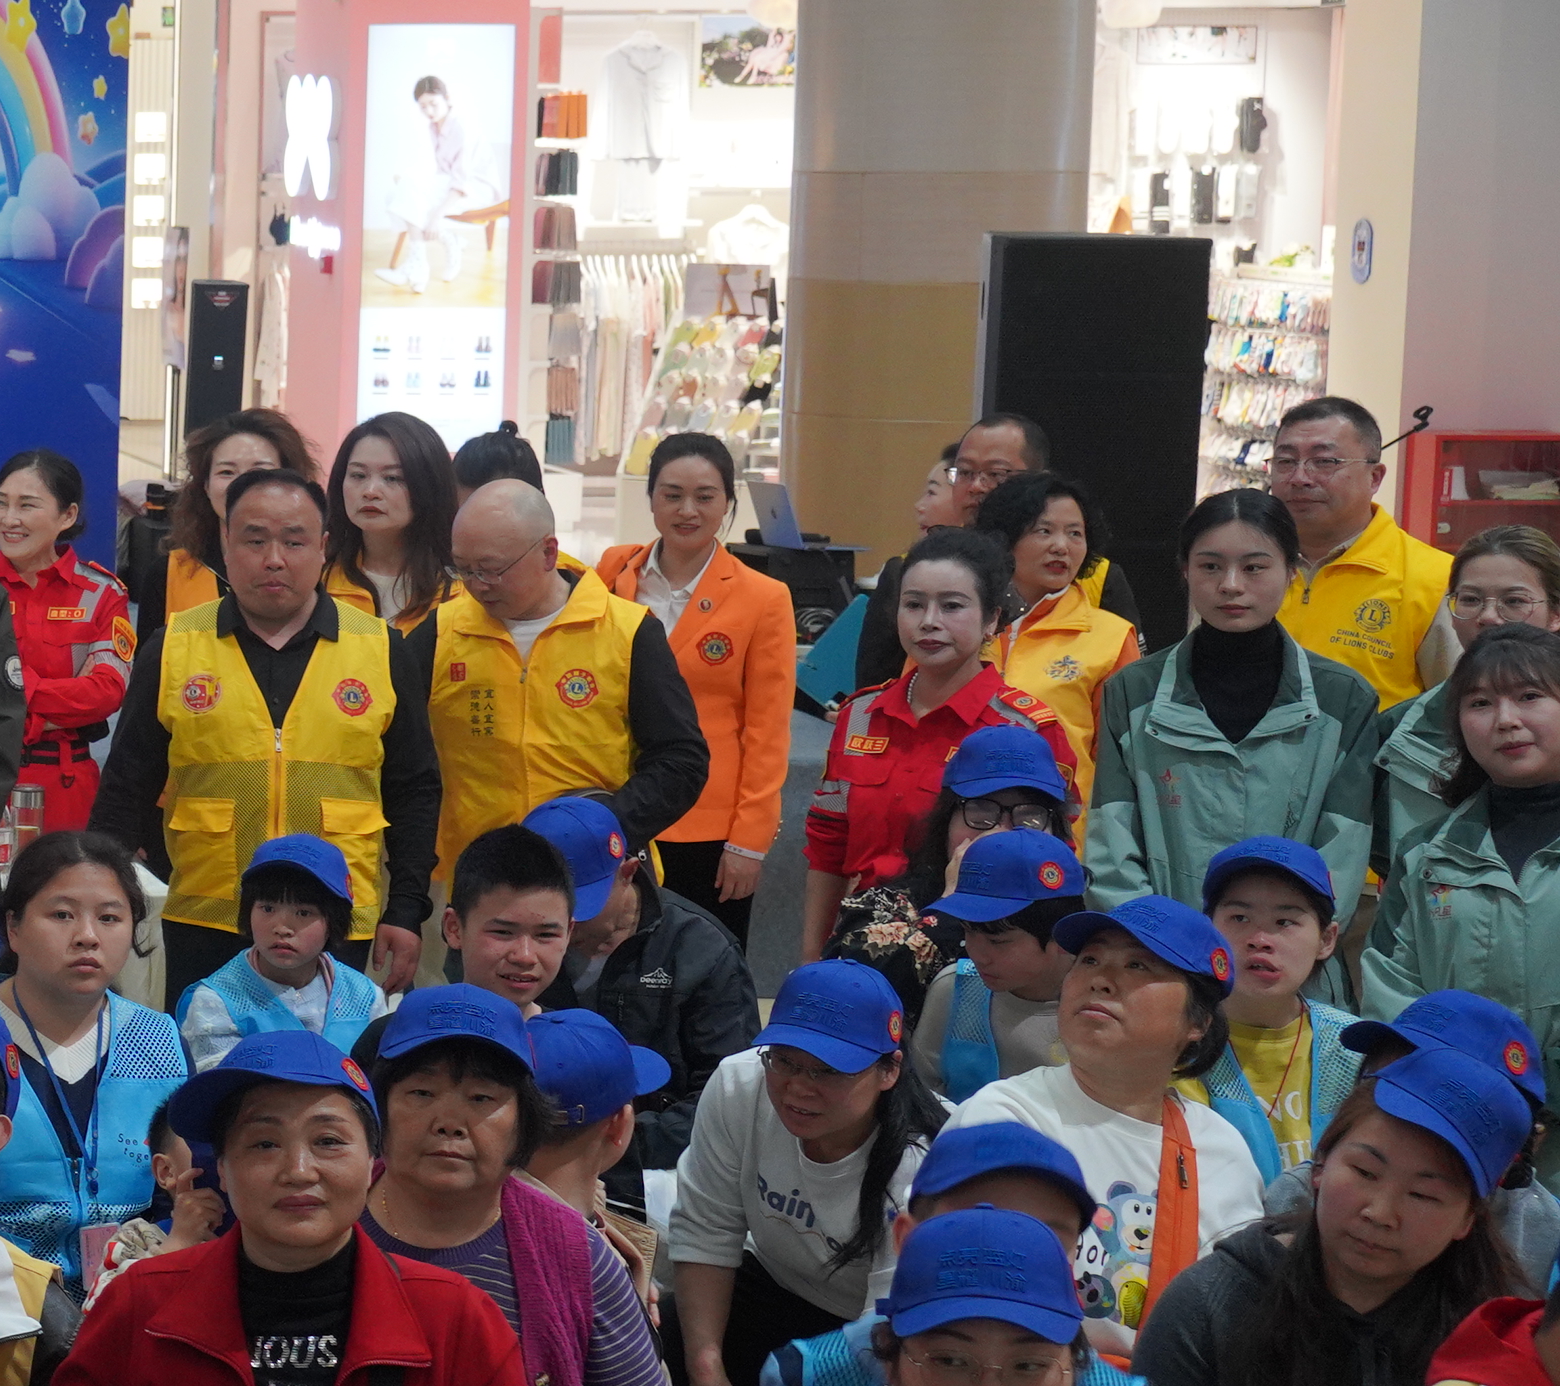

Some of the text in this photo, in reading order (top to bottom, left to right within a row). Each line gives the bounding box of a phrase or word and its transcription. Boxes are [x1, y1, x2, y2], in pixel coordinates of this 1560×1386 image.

[1336, 629, 1392, 649] CHINA COUNCIL
[1343, 638, 1367, 651] LIONS
[1368, 644, 1395, 660] CLUBS
